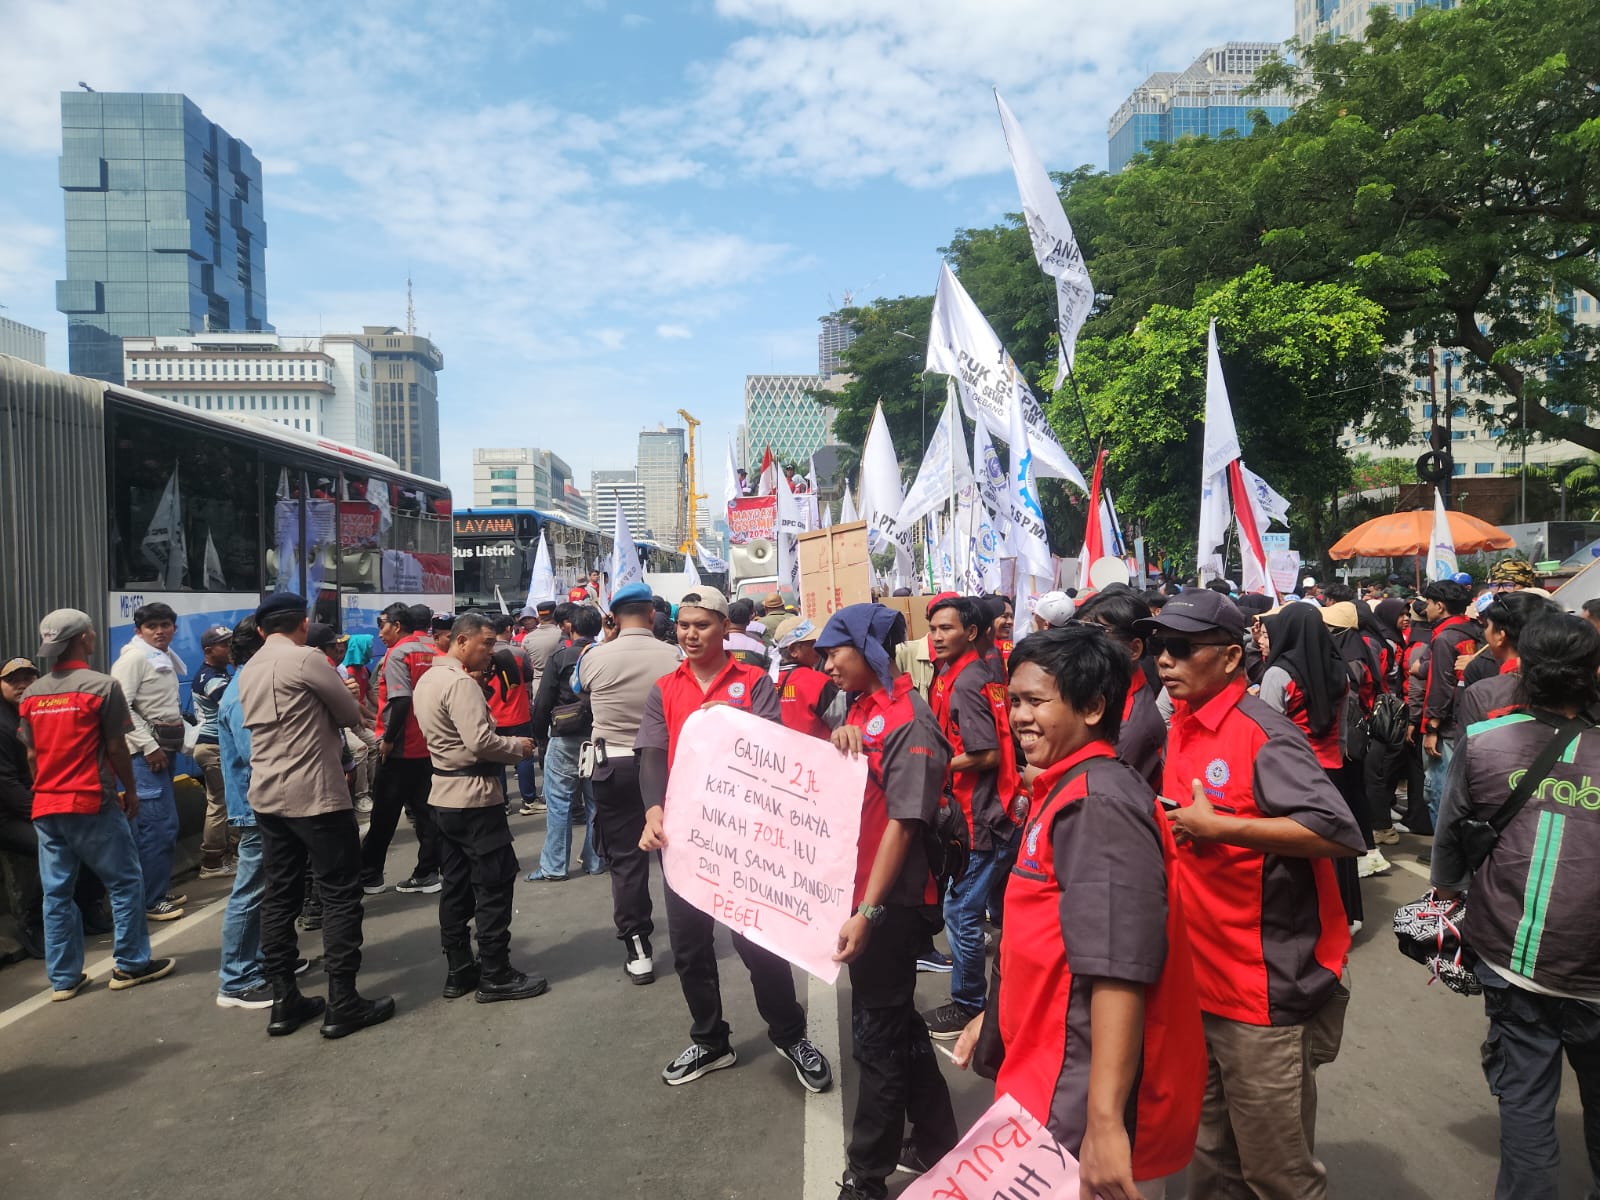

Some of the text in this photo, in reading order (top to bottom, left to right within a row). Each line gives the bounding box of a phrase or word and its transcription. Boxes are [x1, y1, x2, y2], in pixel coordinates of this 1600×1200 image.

[957, 350, 991, 381] PUK
[971, 392, 1004, 417] GEBANG
[455, 518, 516, 533] LAYANA
[732, 507, 773, 521] MAYDAY
[475, 544, 516, 557] Listrik
[734, 737, 786, 774] GAJIAN
[701, 804, 747, 837] NIKAH
[744, 789, 784, 818] EMAK
[790, 809, 831, 839] BIAYA
[744, 849, 787, 880] SAMA
[790, 871, 845, 907] DANGDUT
[713, 893, 763, 932] PEGEL
[733, 870, 813, 922] BIDUANNYA
